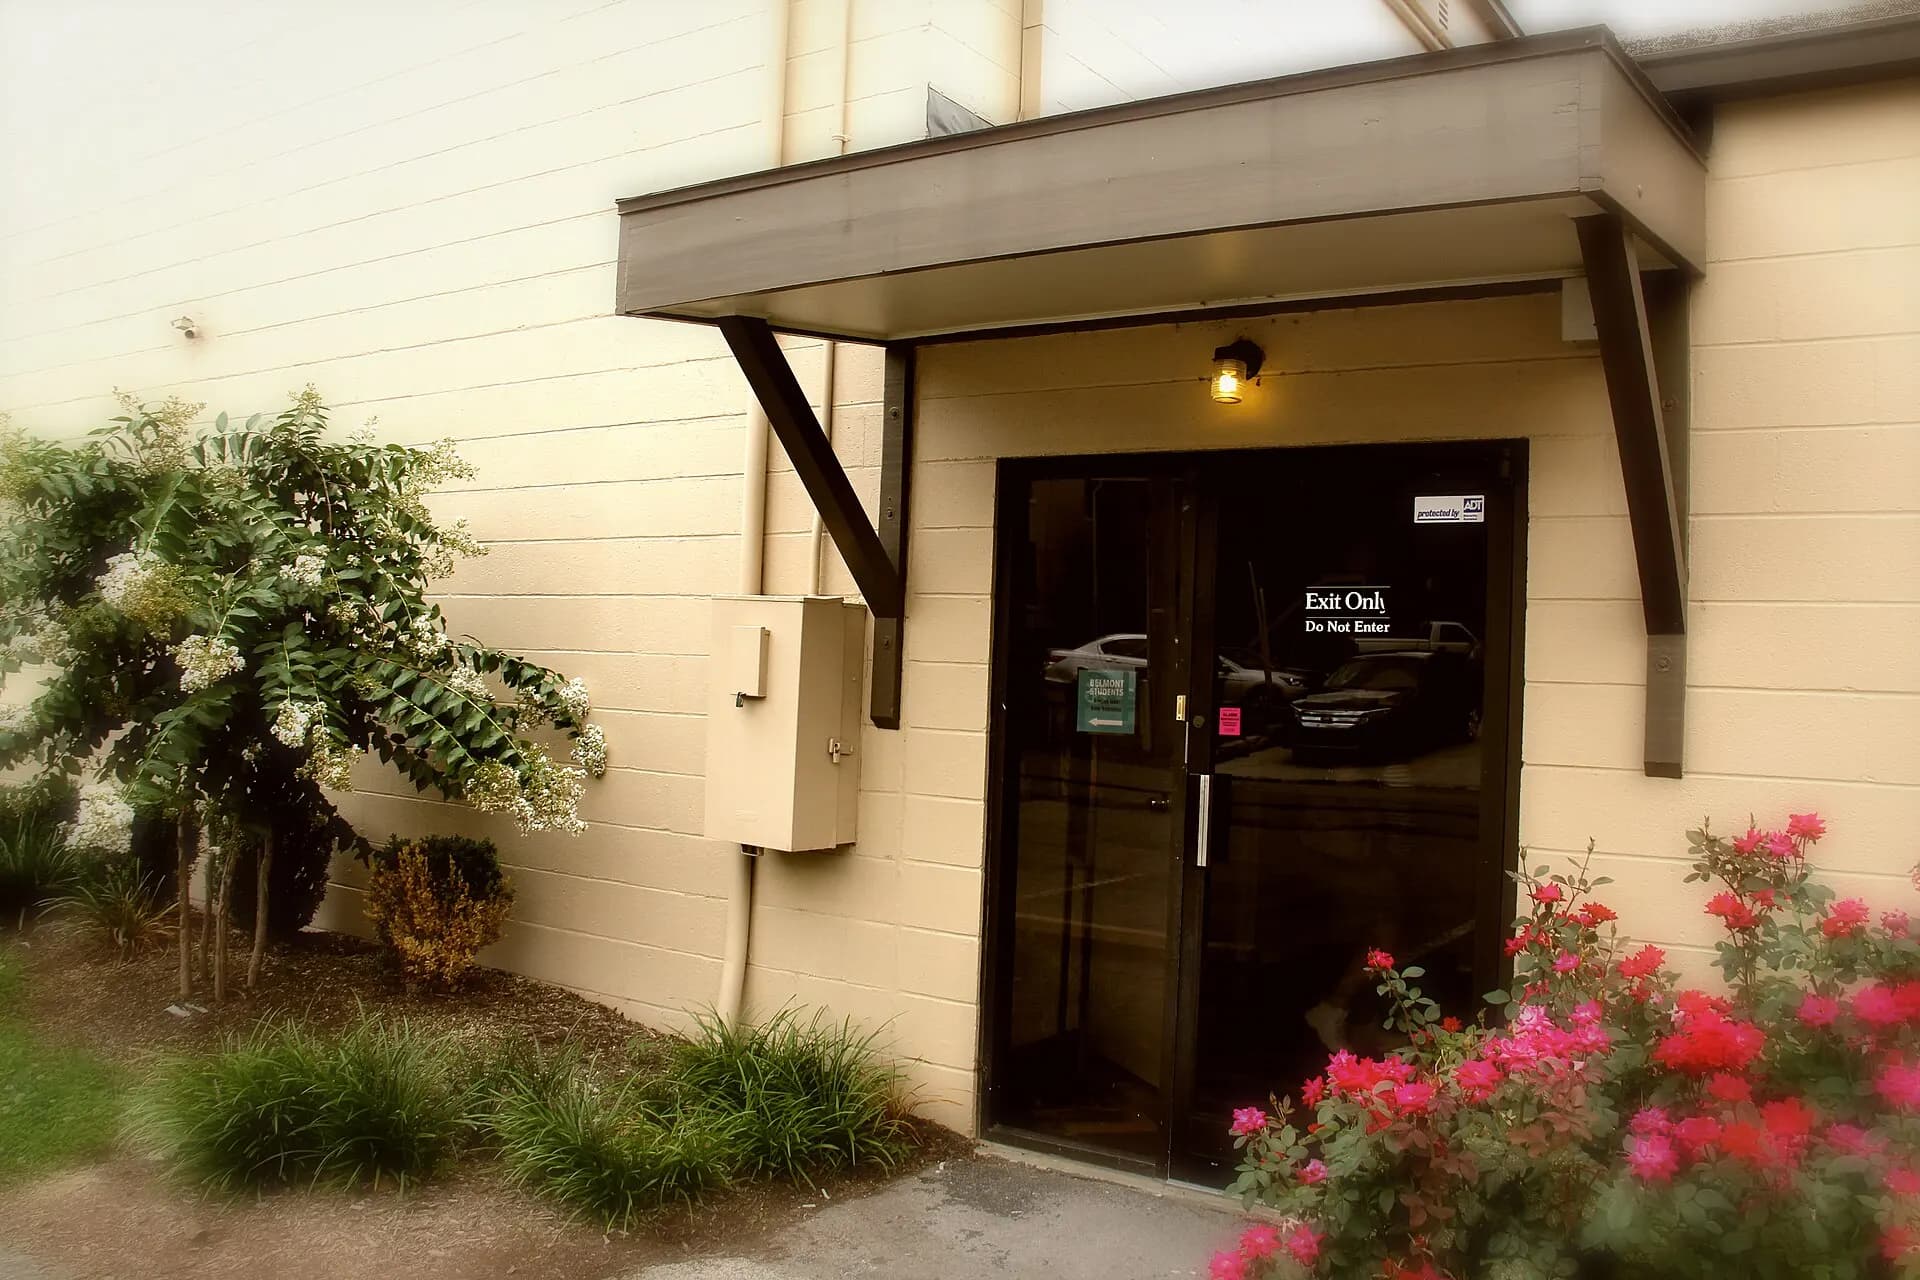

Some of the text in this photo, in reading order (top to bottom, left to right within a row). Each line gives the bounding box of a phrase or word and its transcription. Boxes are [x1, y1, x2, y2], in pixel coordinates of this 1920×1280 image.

[1464, 500, 1482, 510] ADT
[1418, 509, 1460, 518] protected by
[1305, 592, 1341, 610] Exit
[1305, 620, 1390, 632] Do Not Enter
[1089, 679, 1124, 688] BELMONT
[1089, 687, 1124, 696] STUDENTS
